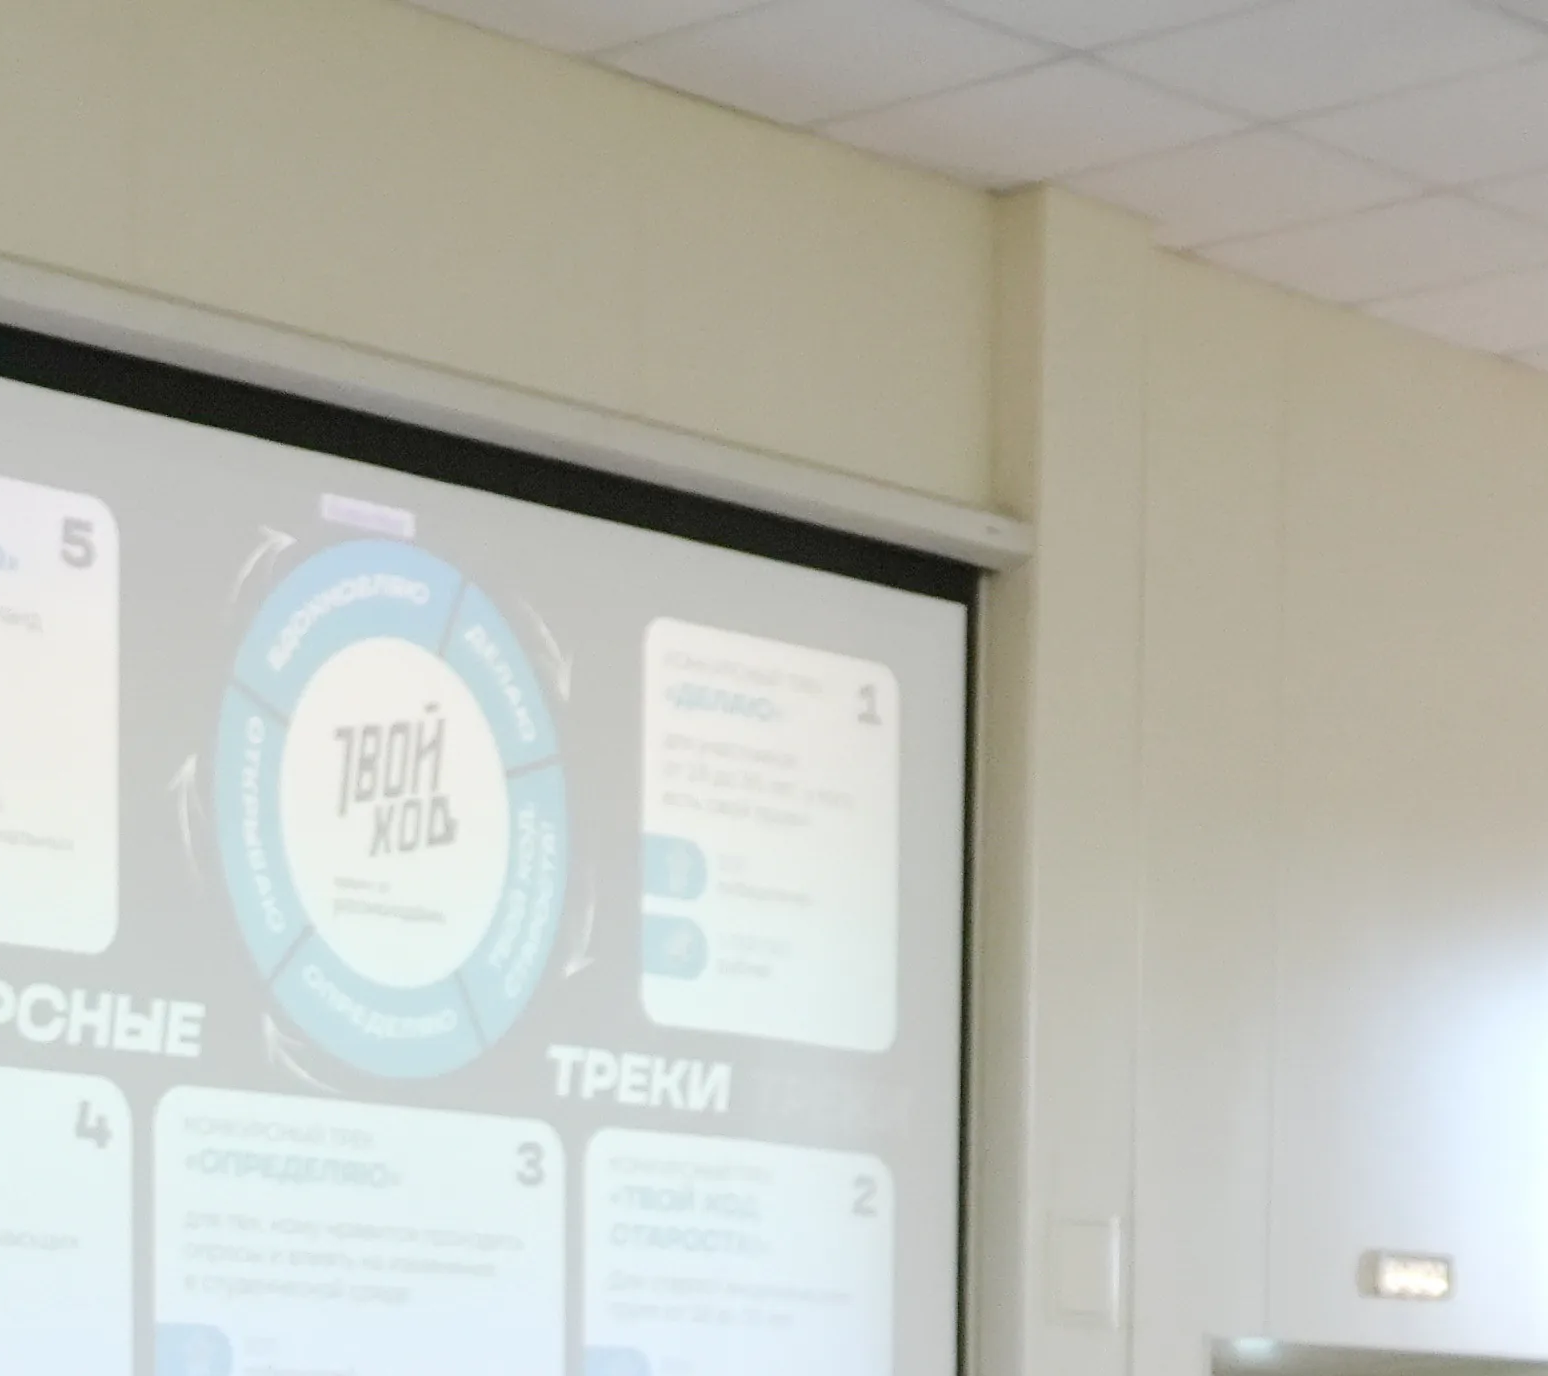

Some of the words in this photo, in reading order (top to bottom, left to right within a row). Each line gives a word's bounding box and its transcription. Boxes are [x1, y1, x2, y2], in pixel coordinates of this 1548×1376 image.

[60, 516, 98, 570] 5
[856, 683, 884, 726] 1
[332, 700, 448, 818] ТВОЙ
[368, 795, 458, 858] ХОД
[546, 1043, 733, 1113] ТРЕКИ
[73, 1098, 114, 1150] 4
[514, 1140, 547, 1188] 3
[851, 1173, 880, 1218] 2
